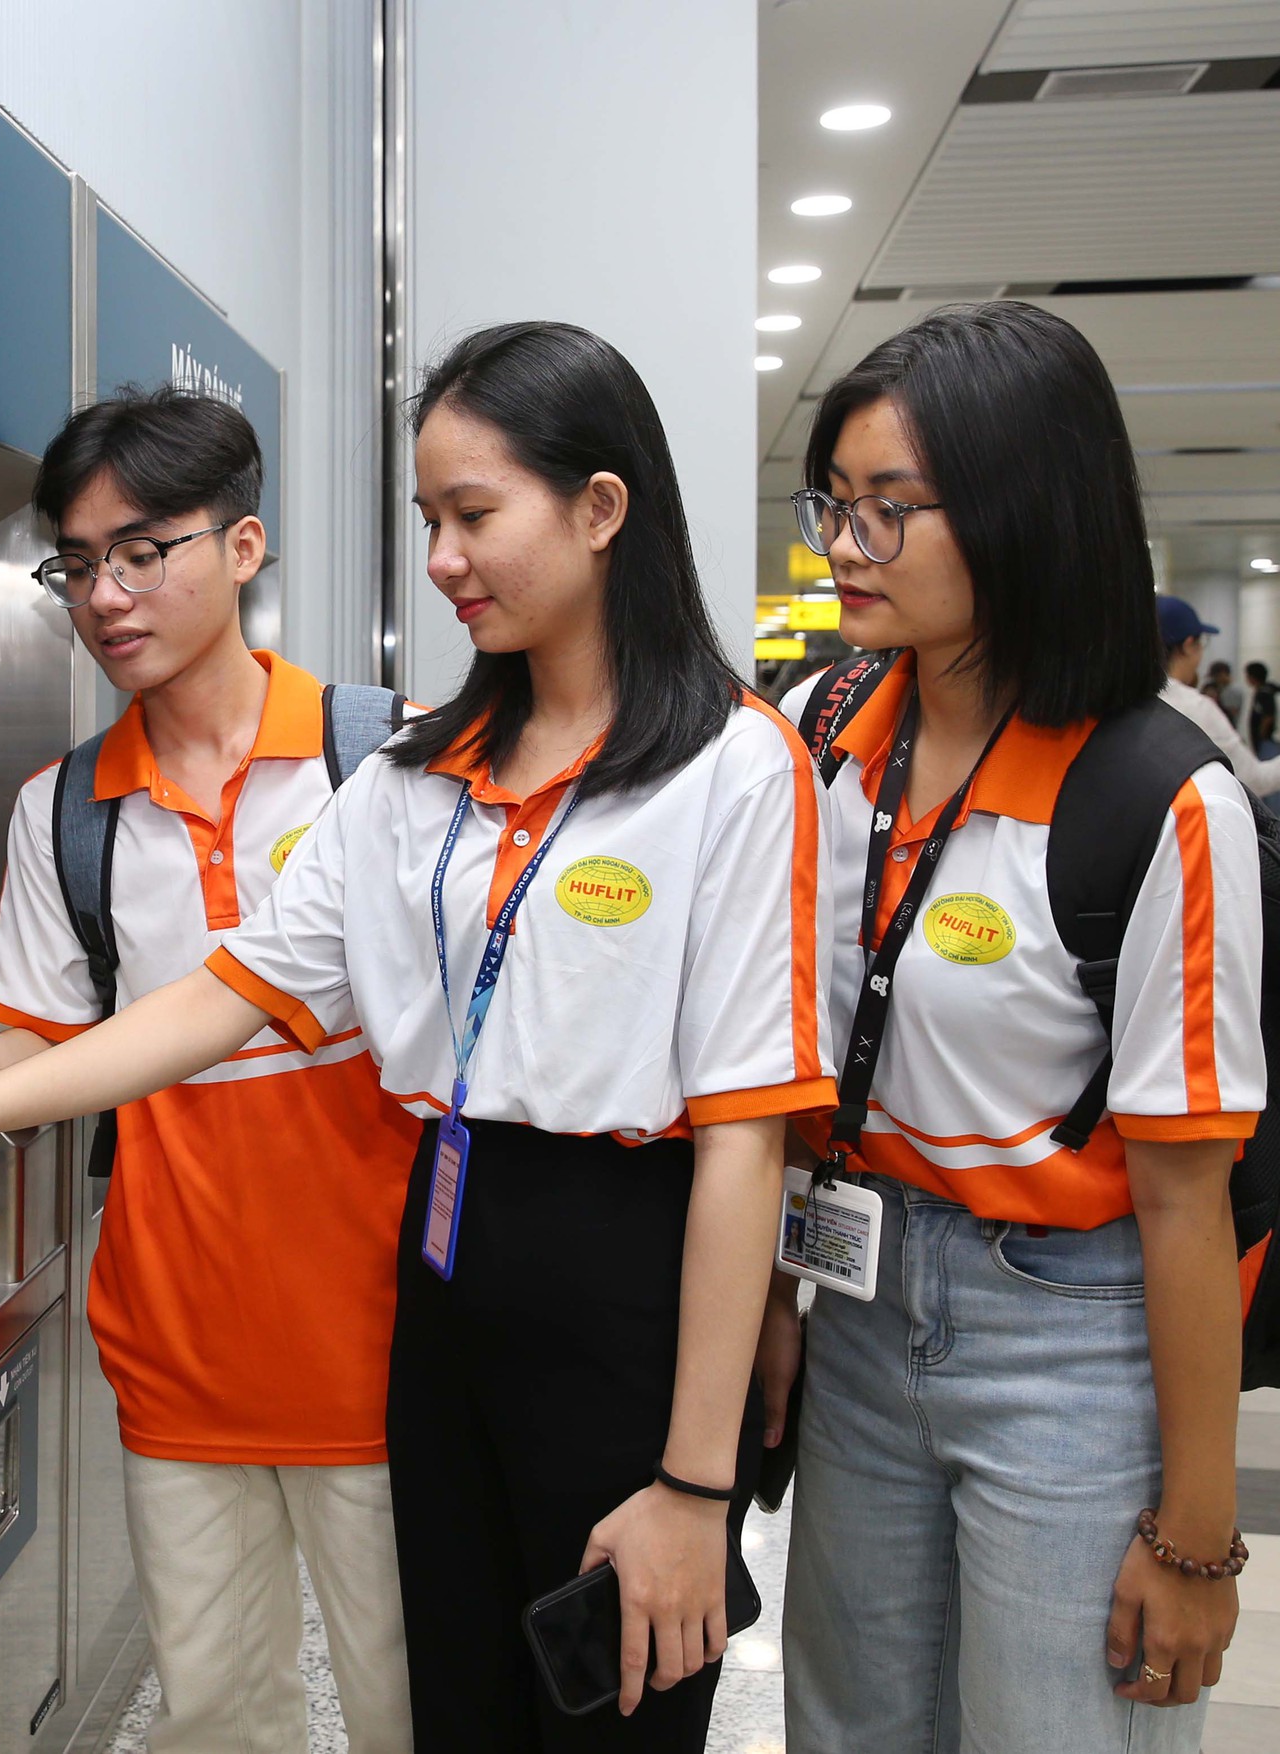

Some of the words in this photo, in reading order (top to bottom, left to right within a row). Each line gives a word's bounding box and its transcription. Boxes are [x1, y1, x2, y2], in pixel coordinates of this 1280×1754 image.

[810, 660, 870, 763] UFLITer
[438, 848, 449, 869] HỌC
[533, 852, 543, 865] OF
[589, 859, 601, 867] HỌC
[434, 869, 443, 888] ĐẠI
[498, 867, 533, 928] EDUCATION
[569, 880, 638, 902] HUFLIT
[433, 889, 441, 931] TRƯỜNG
[930, 897, 954, 912] TRƯỜNG
[939, 912, 1000, 942] HUFLIT
